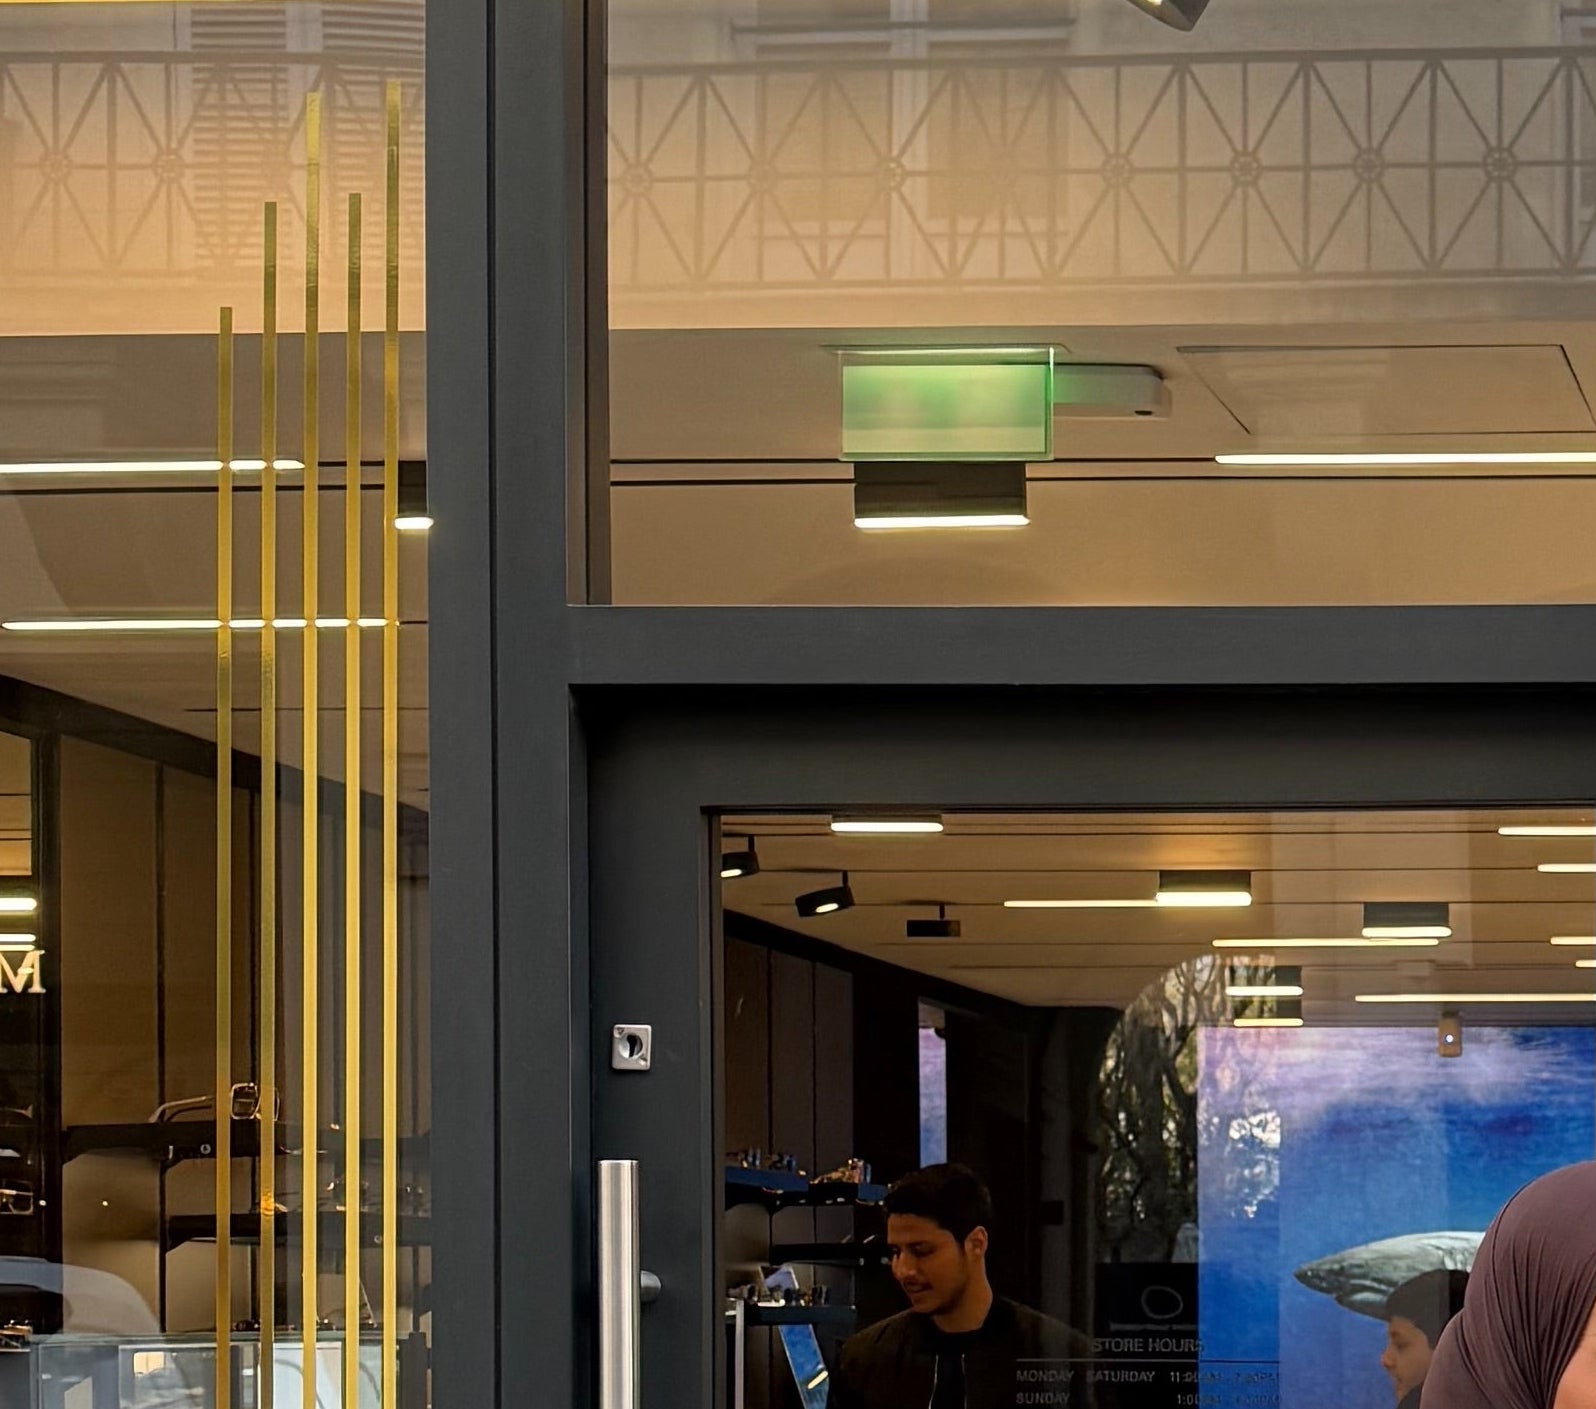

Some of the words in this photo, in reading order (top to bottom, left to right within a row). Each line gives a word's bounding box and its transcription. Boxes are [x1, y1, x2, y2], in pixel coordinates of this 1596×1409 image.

[1092, 1337, 1145, 1352] STORE
[1148, 1337, 1205, 1353] HOURS
[1015, 1369, 1075, 1383] MONDAY
[1086, 1369, 1156, 1383] SATURDAY
[1015, 1392, 1071, 1405] SUNDAY
